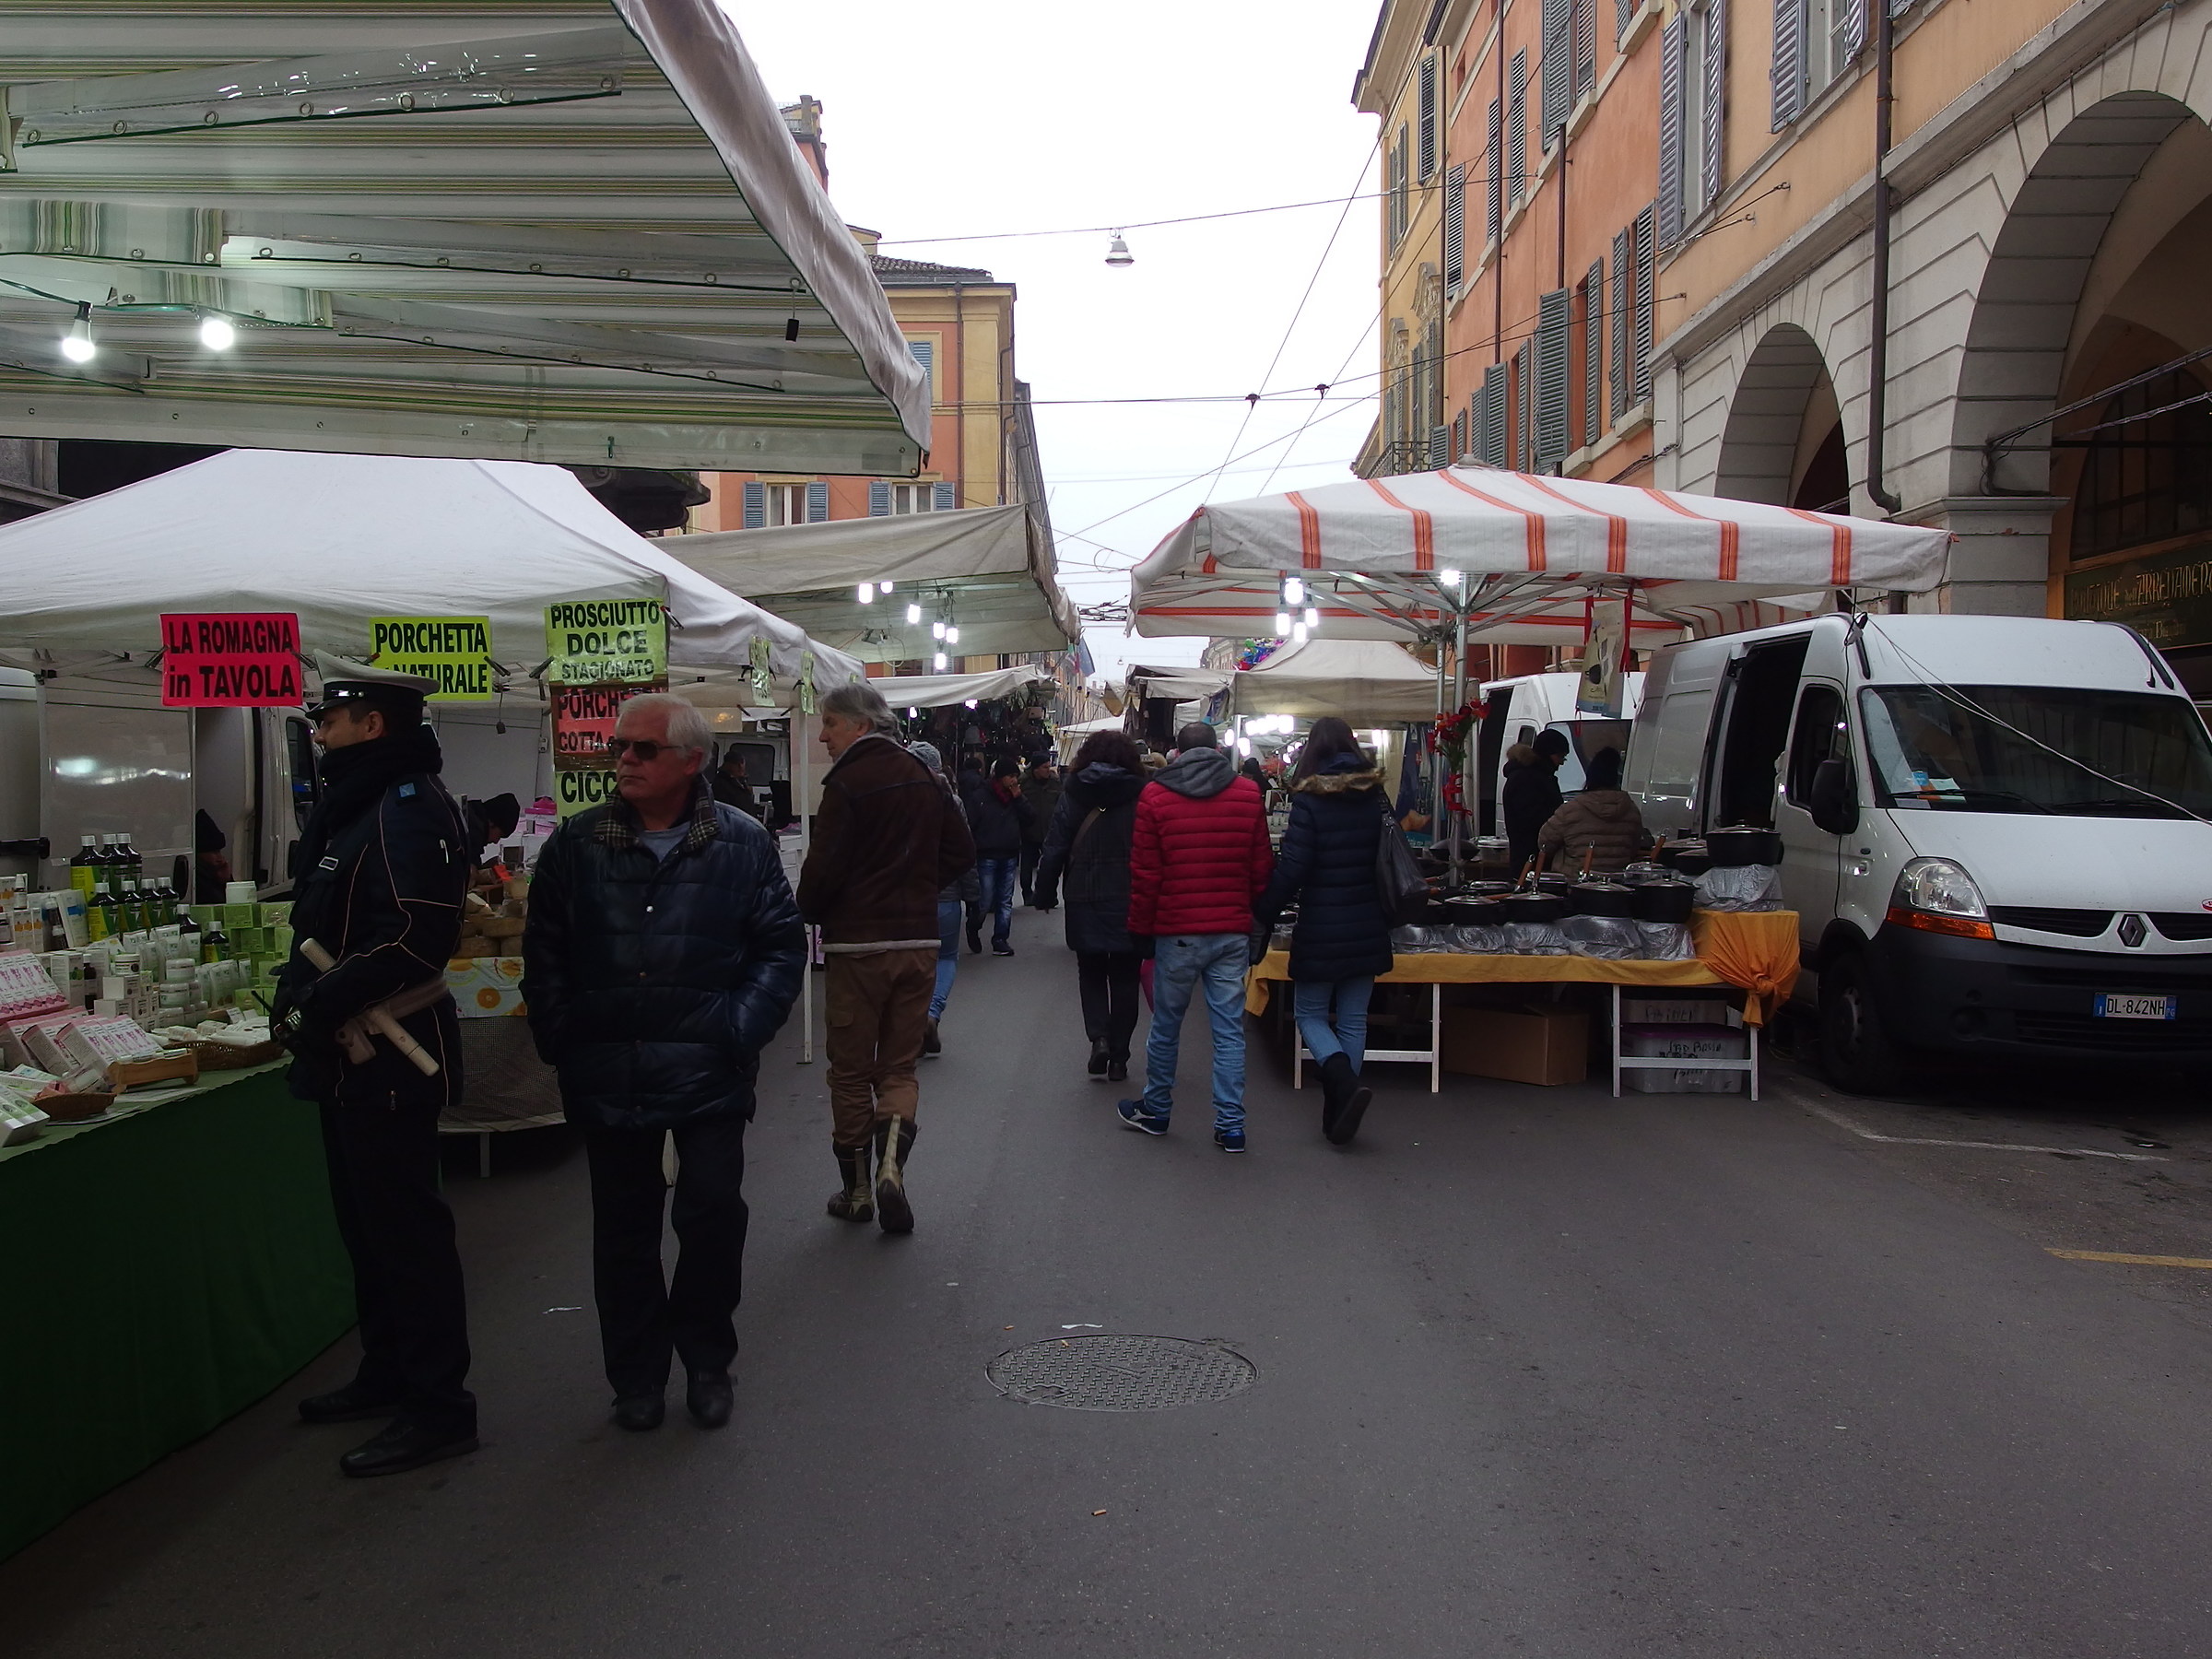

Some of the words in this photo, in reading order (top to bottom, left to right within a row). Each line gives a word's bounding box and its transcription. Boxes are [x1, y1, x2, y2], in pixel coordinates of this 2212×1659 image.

[550, 601, 660, 629] PROSCIUTTO
[168, 621, 194, 653] LA
[197, 620, 293, 653] ROMAGNA
[374, 622, 488, 653] PORCHETTA
[567, 630, 648, 657] DOLCE
[168, 665, 192, 698] in
[199, 665, 296, 698] TAVOLA
[394, 664, 488, 693] TURALE
[559, 688, 629, 719] PORCH
[559, 731, 605, 752] COTTA
[560, 771, 618, 804] CICC
